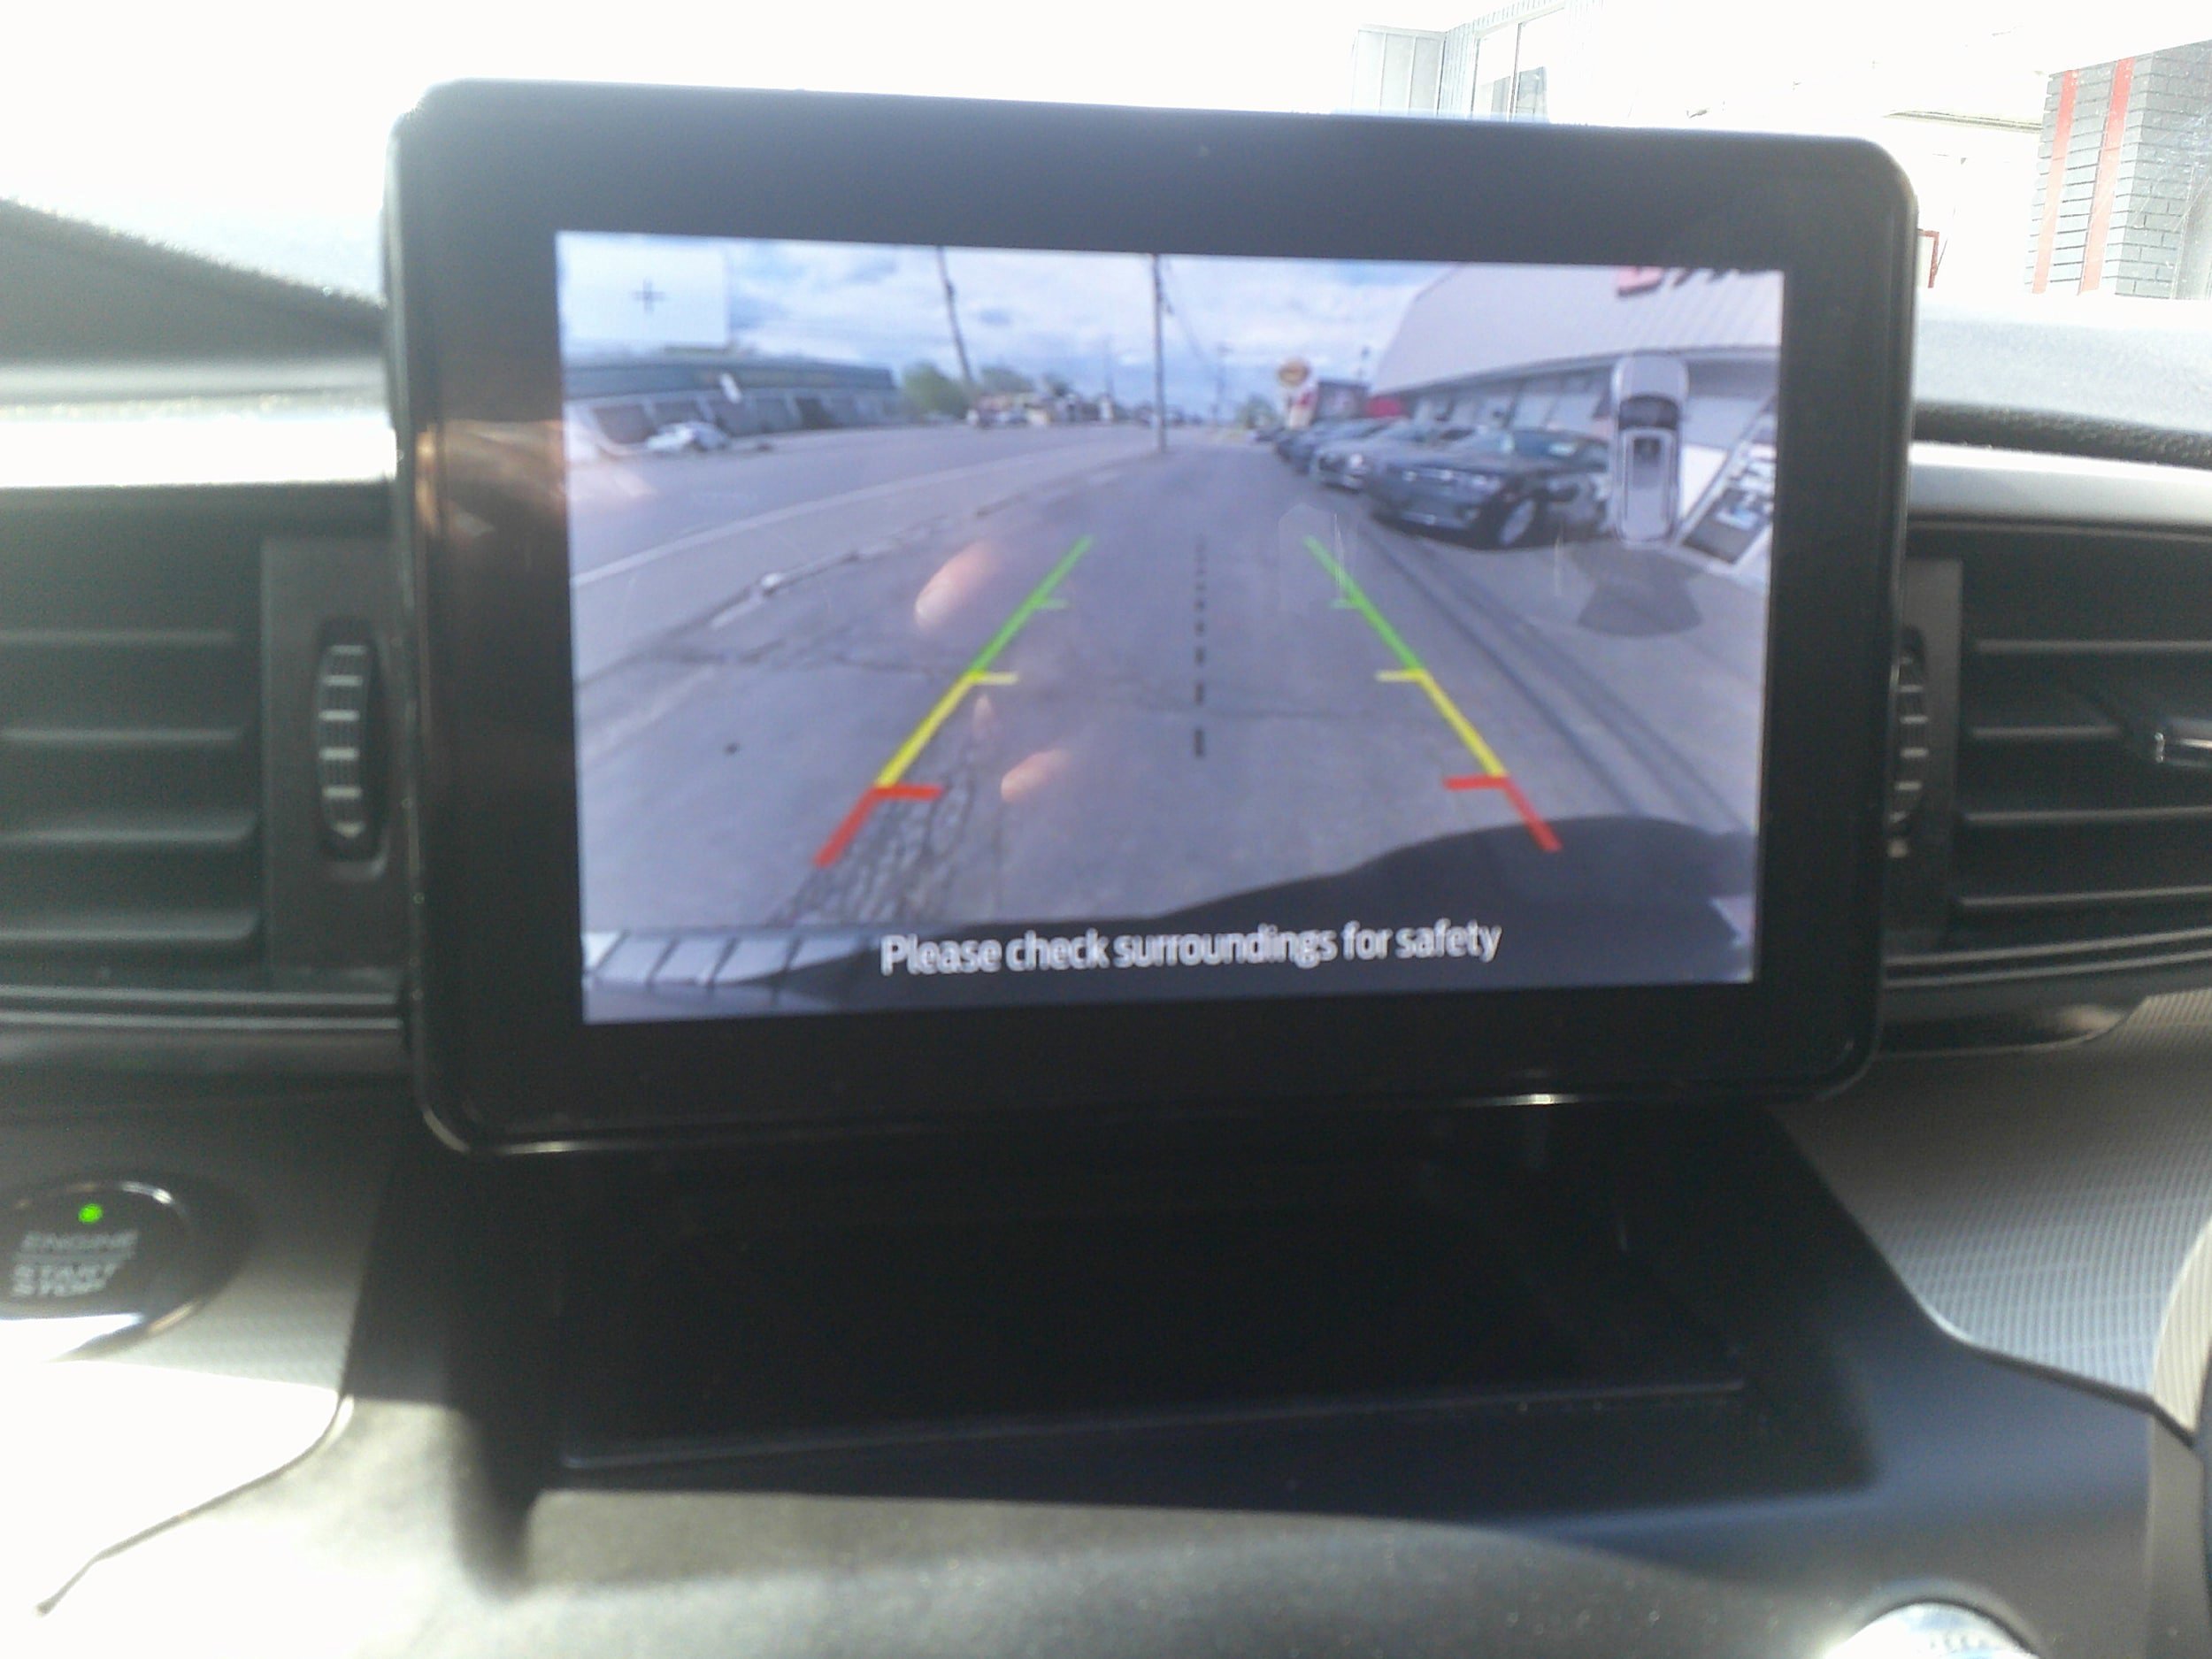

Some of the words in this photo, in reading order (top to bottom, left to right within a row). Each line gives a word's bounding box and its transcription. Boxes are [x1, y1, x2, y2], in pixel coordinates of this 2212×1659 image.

[879, 933, 1002, 976] Please
[1005, 928, 1110, 972] check
[1113, 923, 1337, 970] surroundings
[1341, 919, 1393, 961] for
[1394, 918, 1502, 964] safety
